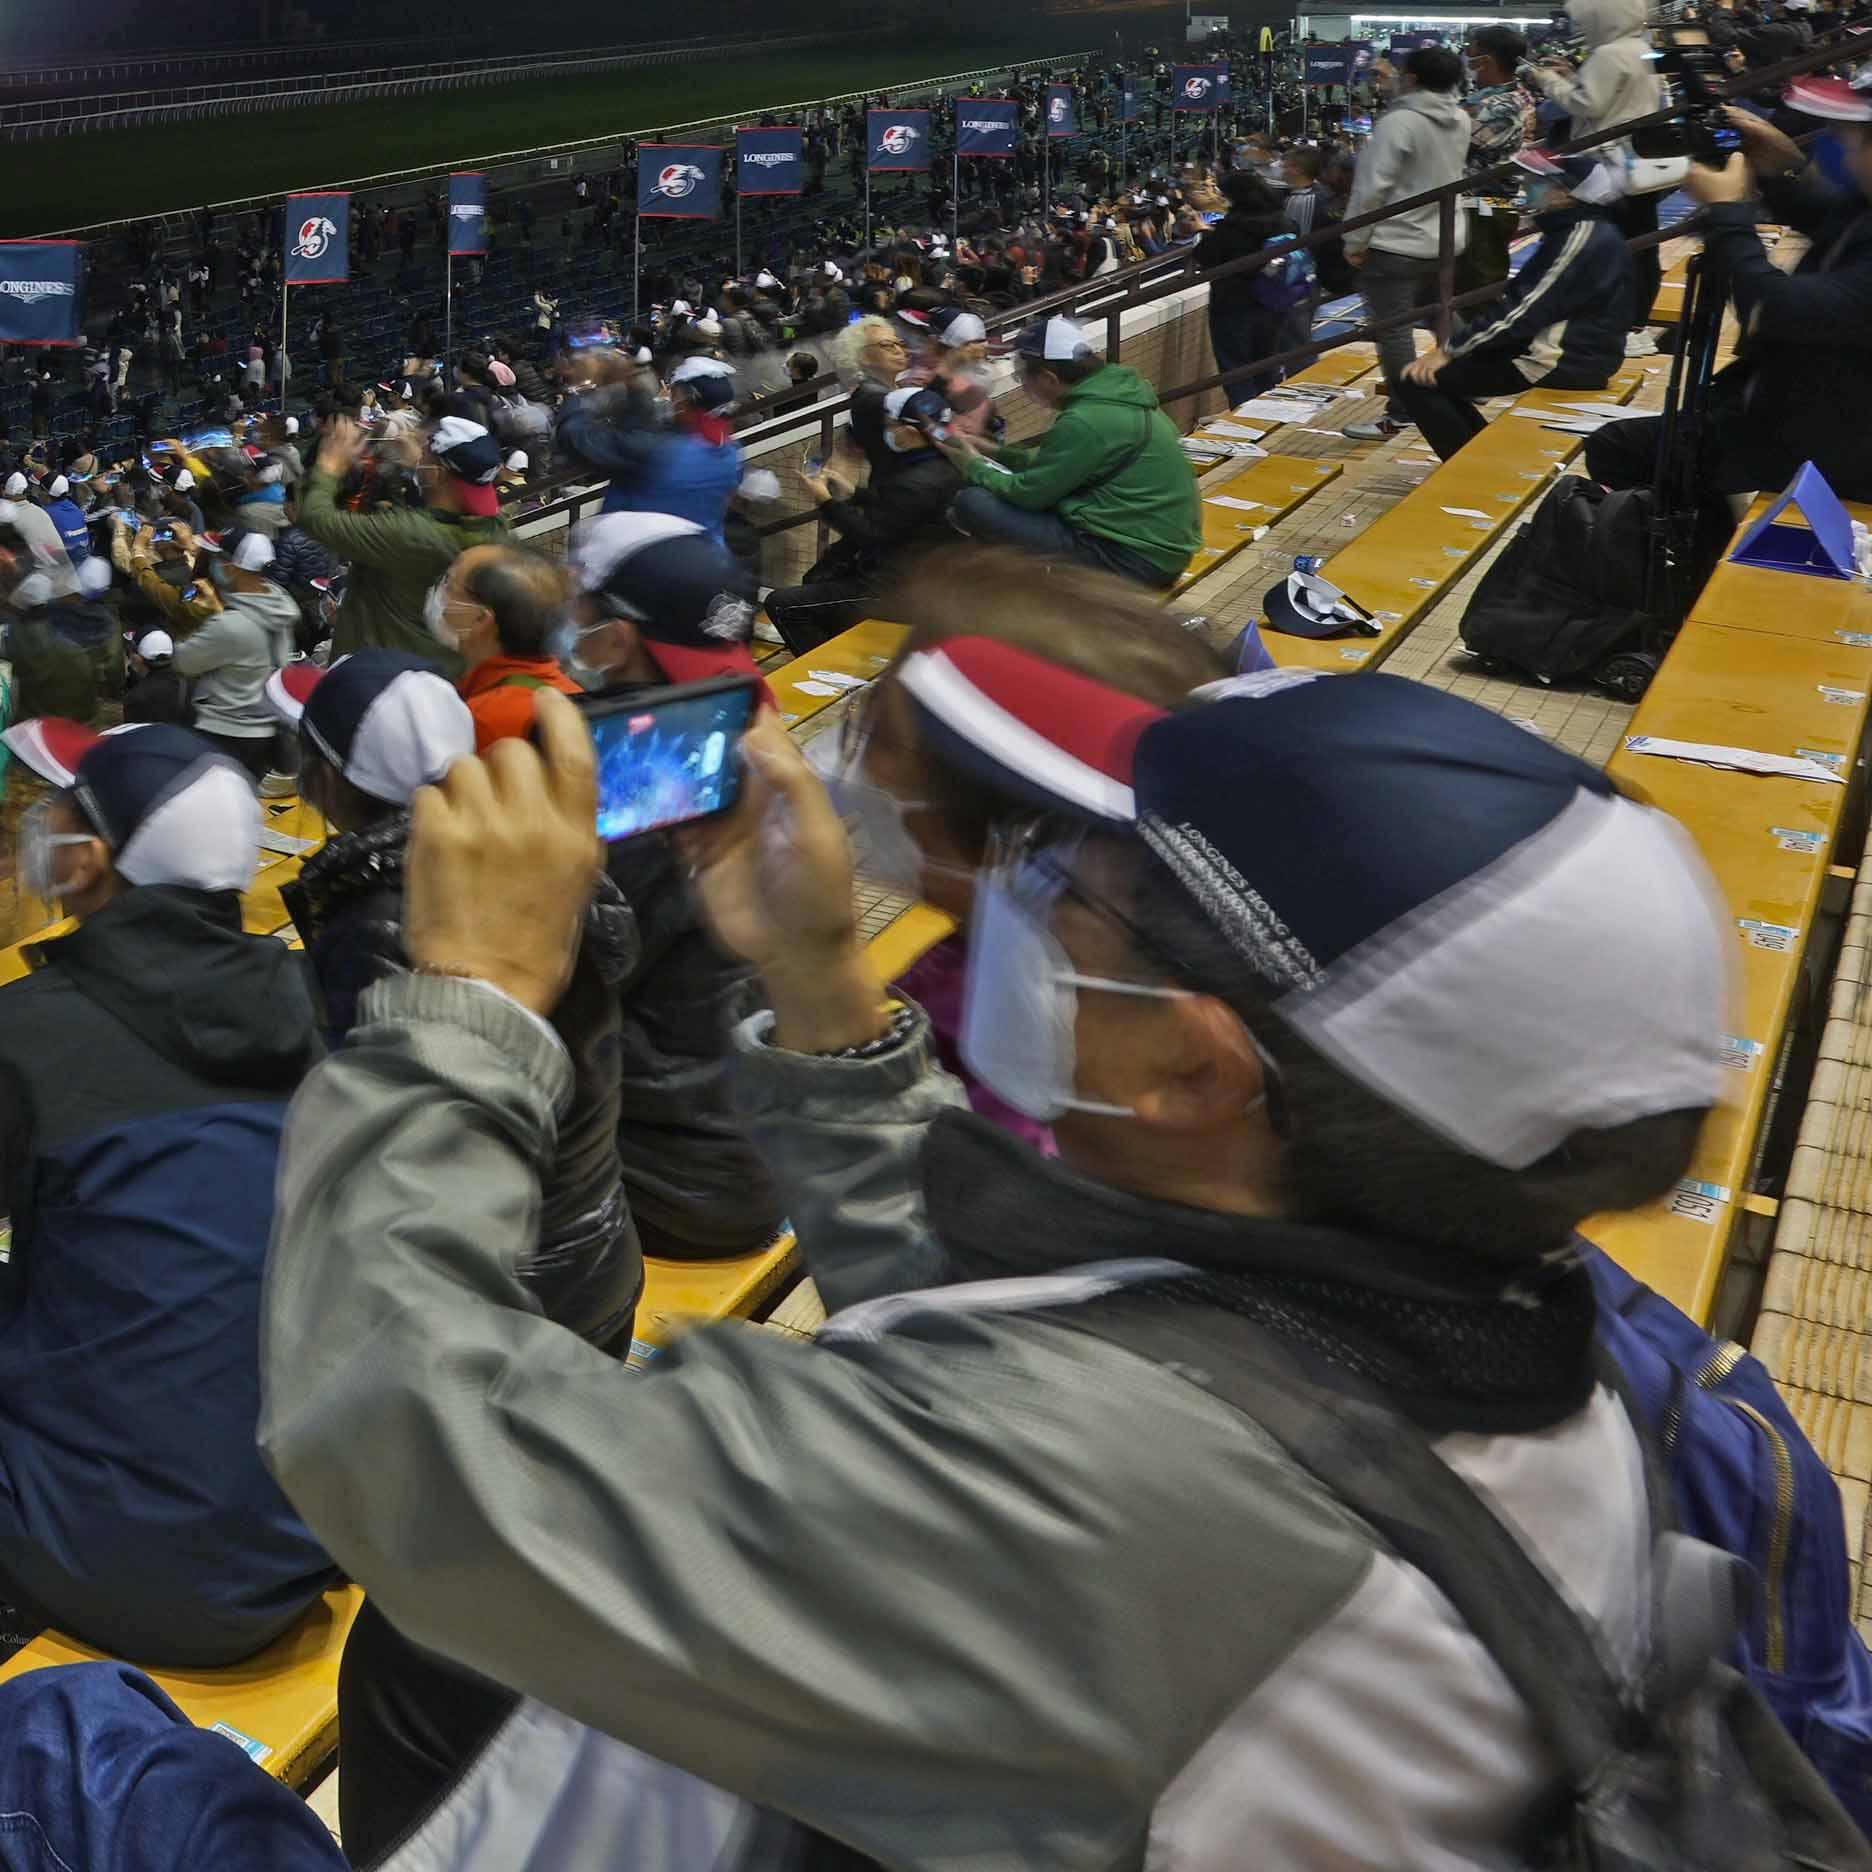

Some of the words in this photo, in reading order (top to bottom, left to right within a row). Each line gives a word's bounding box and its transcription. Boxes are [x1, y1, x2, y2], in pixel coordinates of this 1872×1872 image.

[962, 119, 1010, 131] LONGINES
[743, 151, 794, 164] LONGINES
[1177, 820, 1250, 890] LONGINES
[1244, 887, 1292, 938] HONG
[1671, 1191, 1713, 1219] 051
